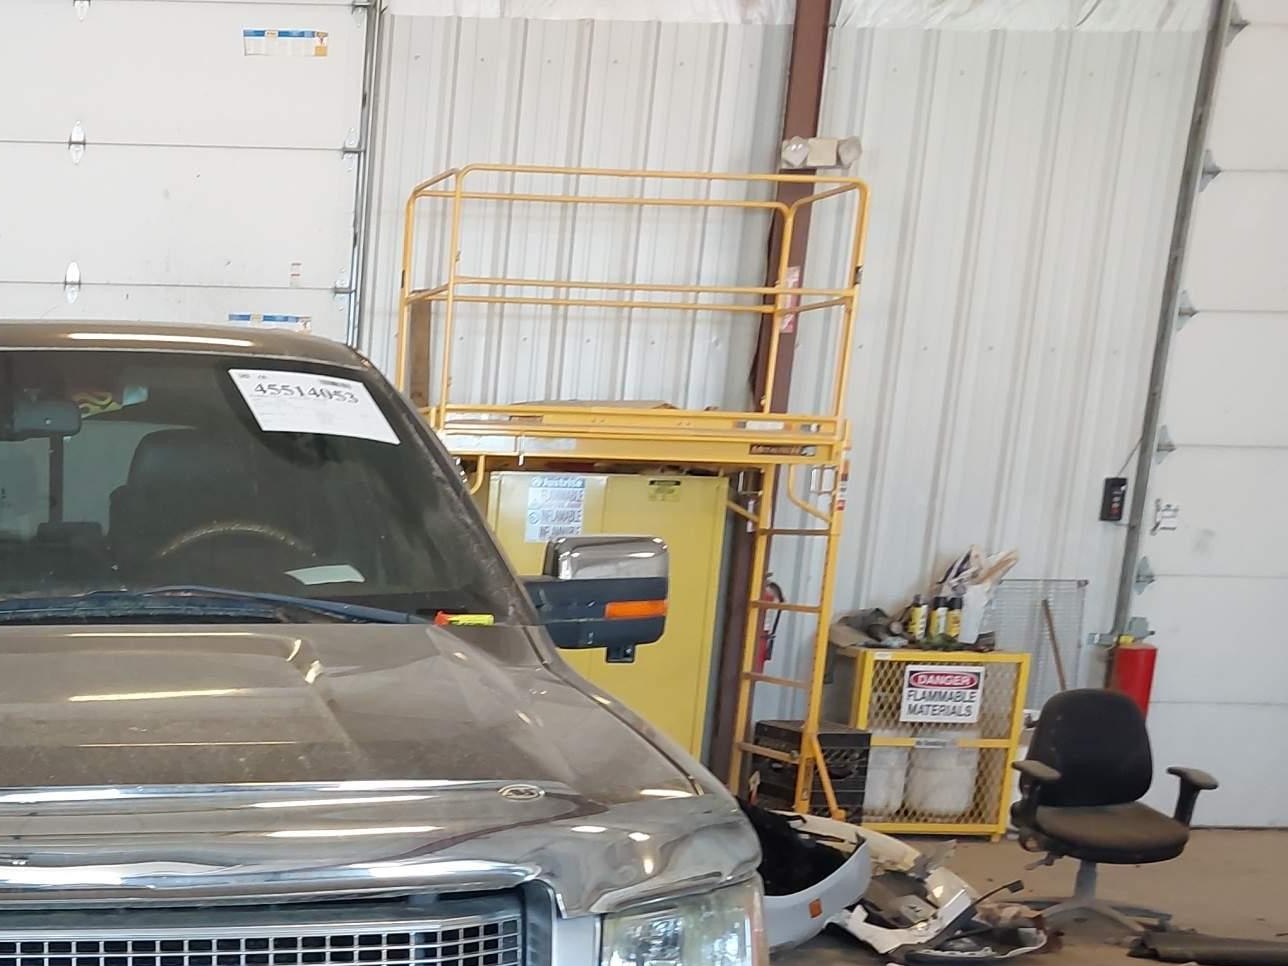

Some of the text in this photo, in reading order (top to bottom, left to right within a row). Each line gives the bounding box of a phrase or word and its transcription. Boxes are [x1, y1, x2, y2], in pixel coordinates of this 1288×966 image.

[254, 383, 359, 404] 45514053
[917, 675, 971, 686] DANGER
[907, 690, 977, 703] FLAMMABLE
[907, 704, 973, 717] MATERIALS
